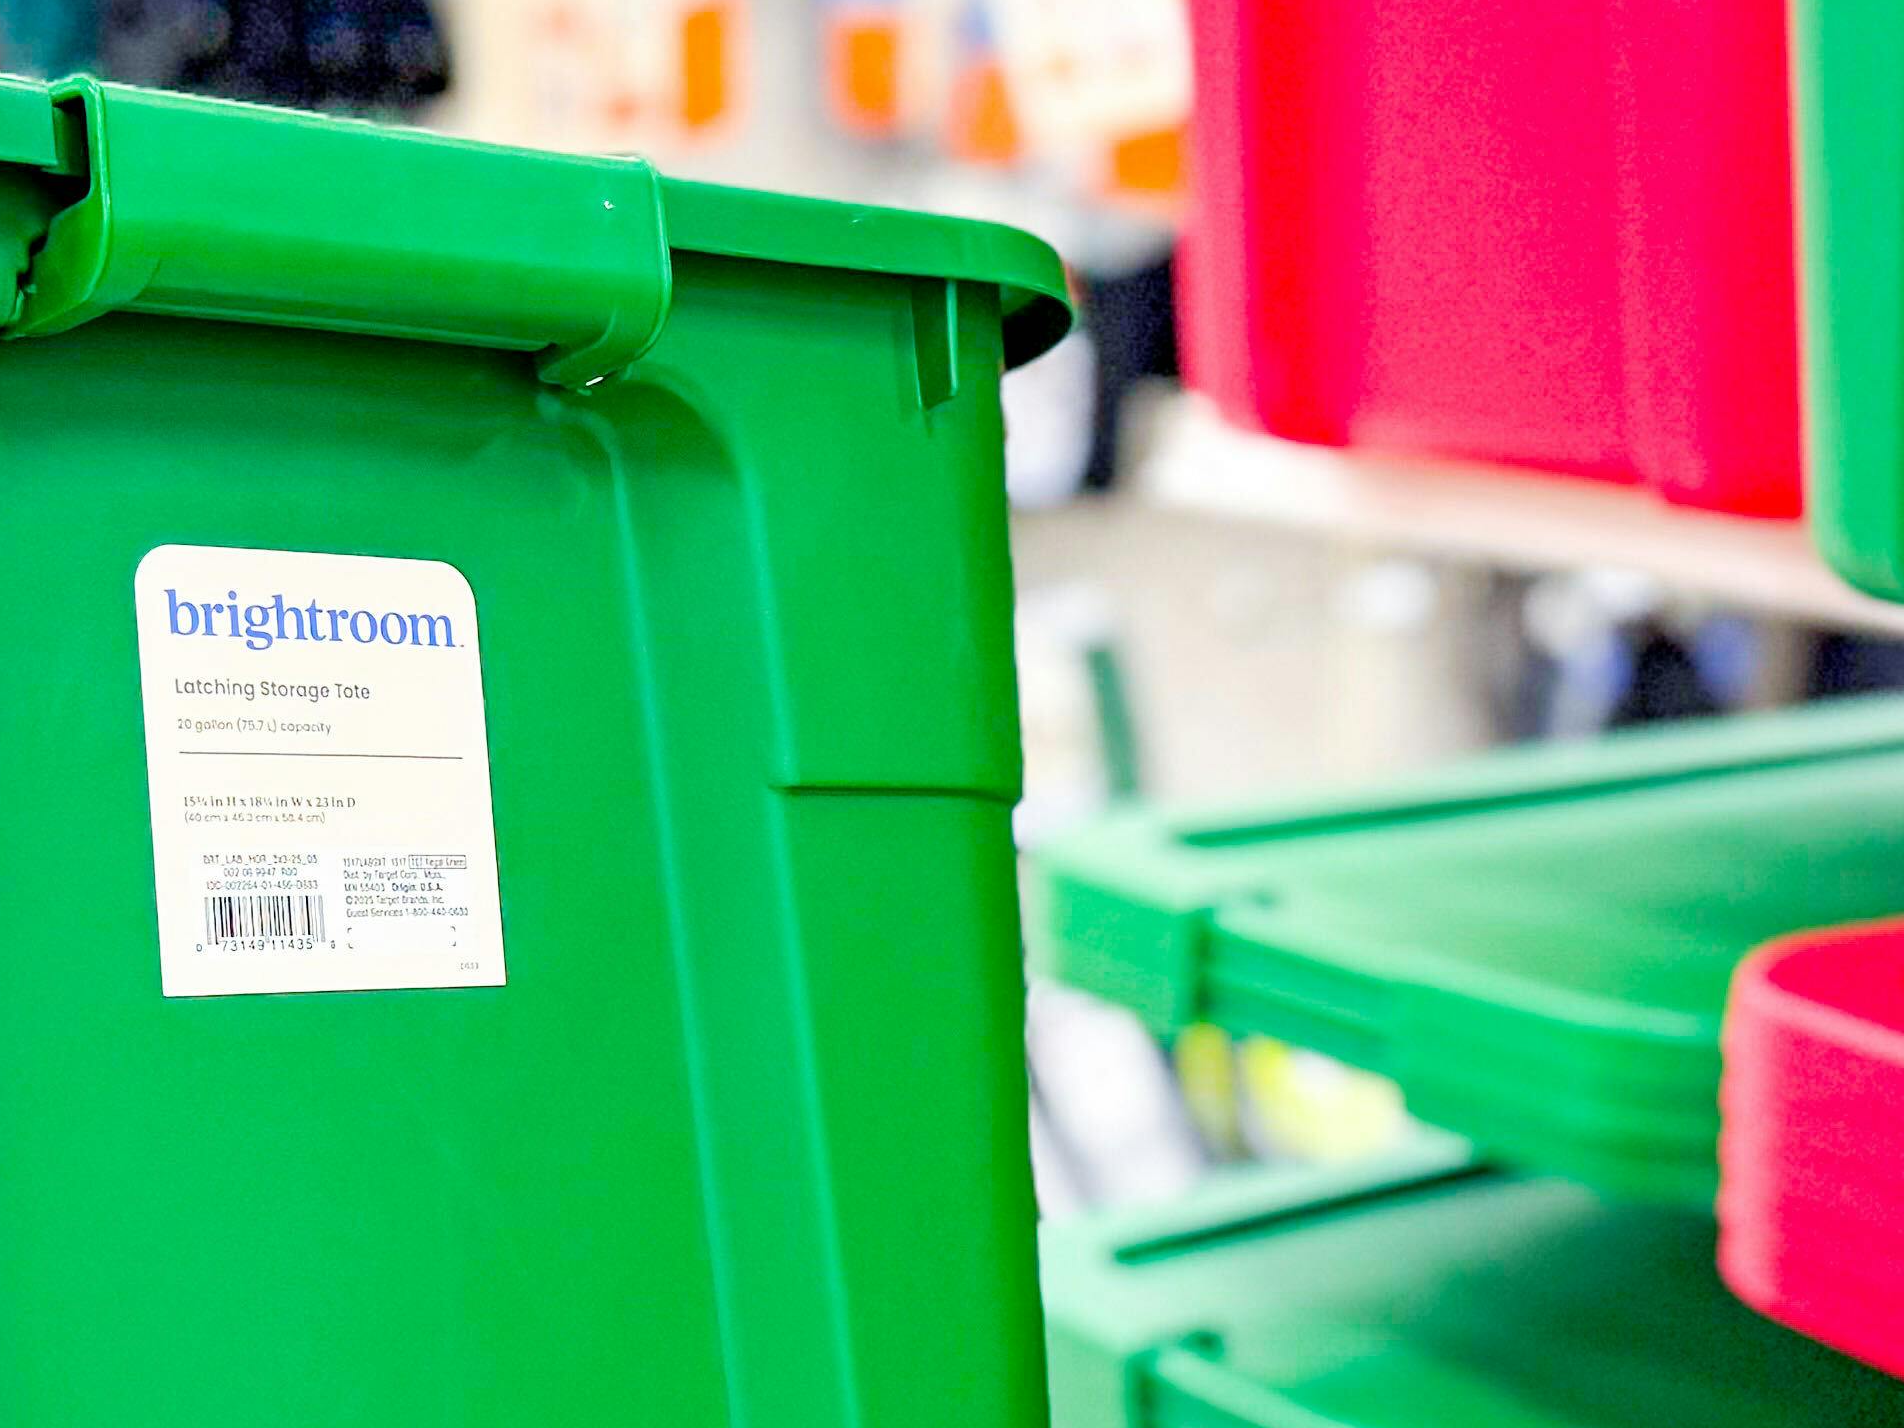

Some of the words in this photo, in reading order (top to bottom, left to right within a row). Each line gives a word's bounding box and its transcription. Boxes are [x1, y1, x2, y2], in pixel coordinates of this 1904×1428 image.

[174, 678, 256, 701] Latching
[260, 680, 330, 703] Storage
[334, 683, 371, 700] Tote
[177, 718, 192, 730] 20
[196, 719, 233, 734] gallon
[280, 720, 332, 736] capacity
[291, 796, 303, 808] W
[315, 797, 329, 808] 23
[347, 797, 356, 808] D
[221, 939, 265, 952] 73149
[271, 938, 313, 951] 11435
